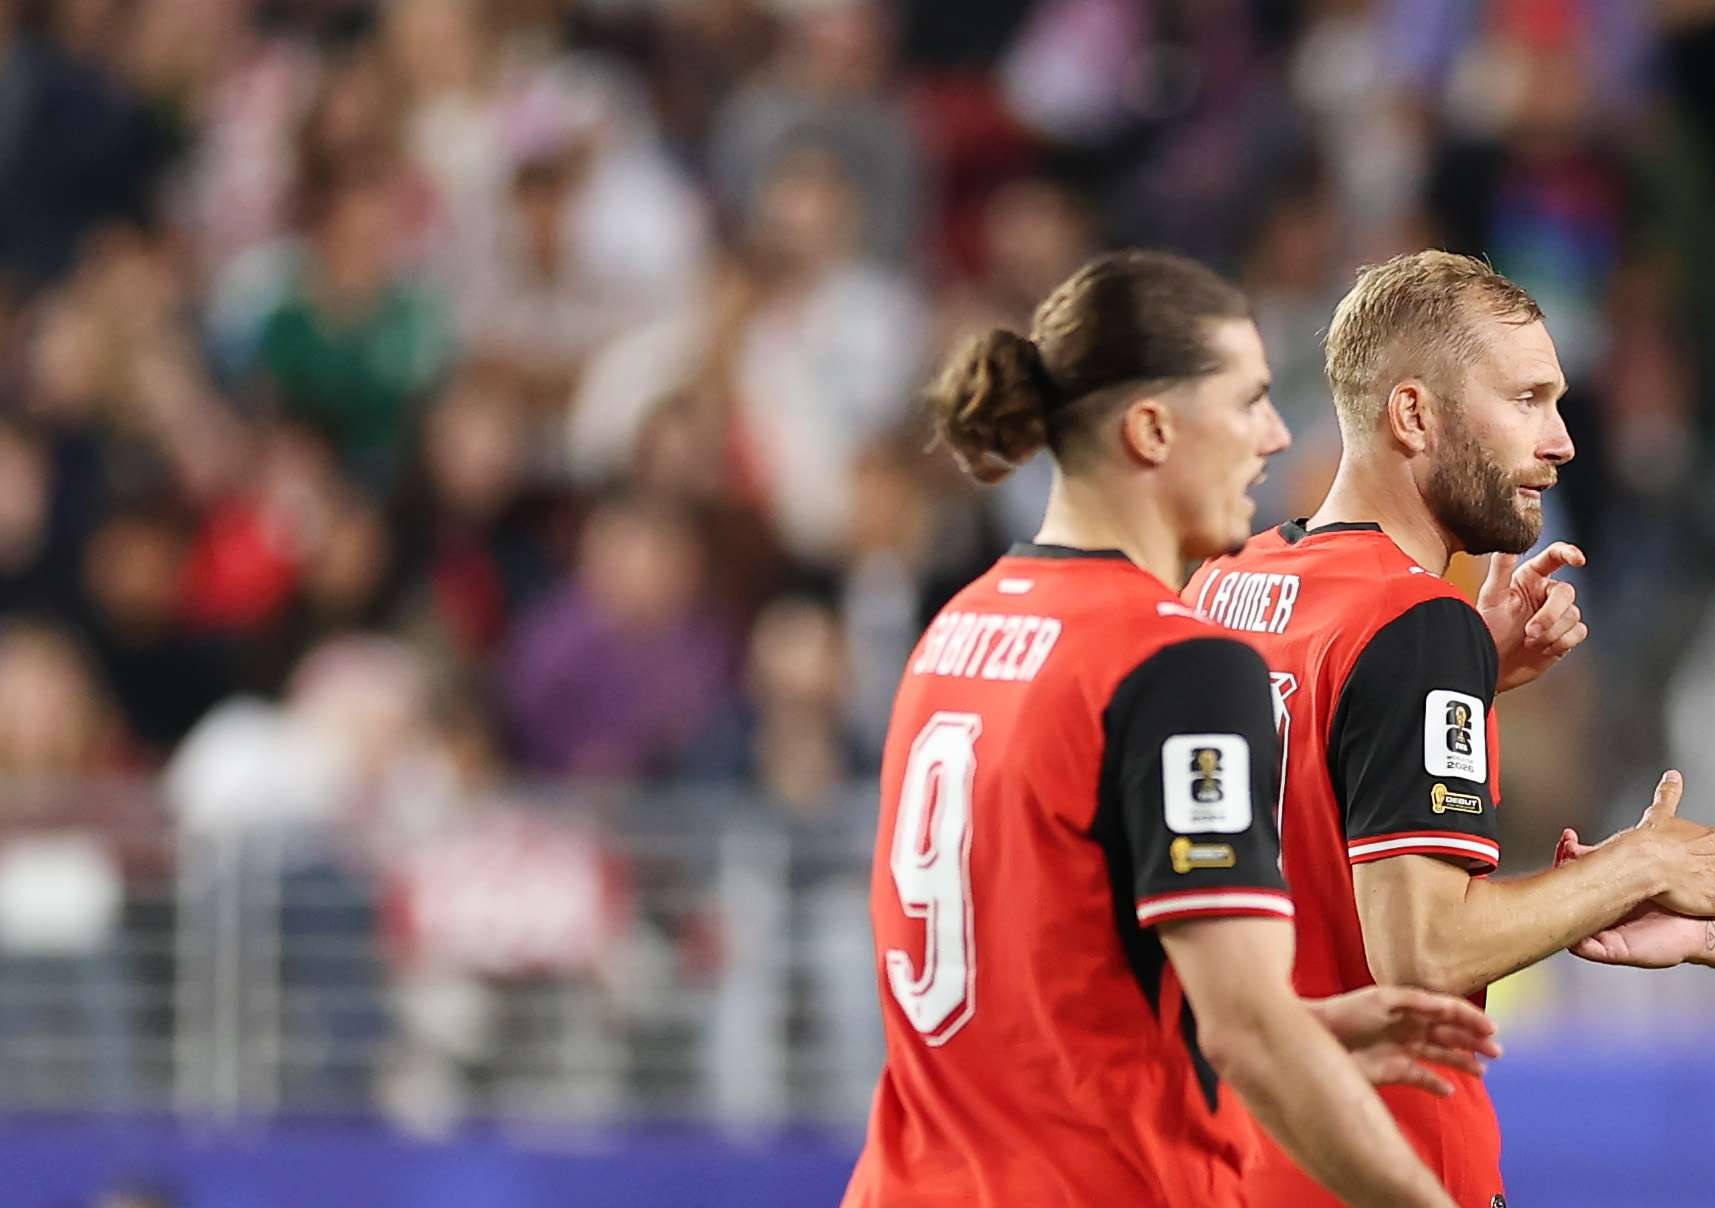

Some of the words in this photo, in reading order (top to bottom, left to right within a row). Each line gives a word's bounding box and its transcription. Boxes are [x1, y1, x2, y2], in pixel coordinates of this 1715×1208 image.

[1197, 568, 1301, 635] LAIMER
[1445, 796, 1478, 807] DEBUT
[887, 711, 982, 1047] 9
